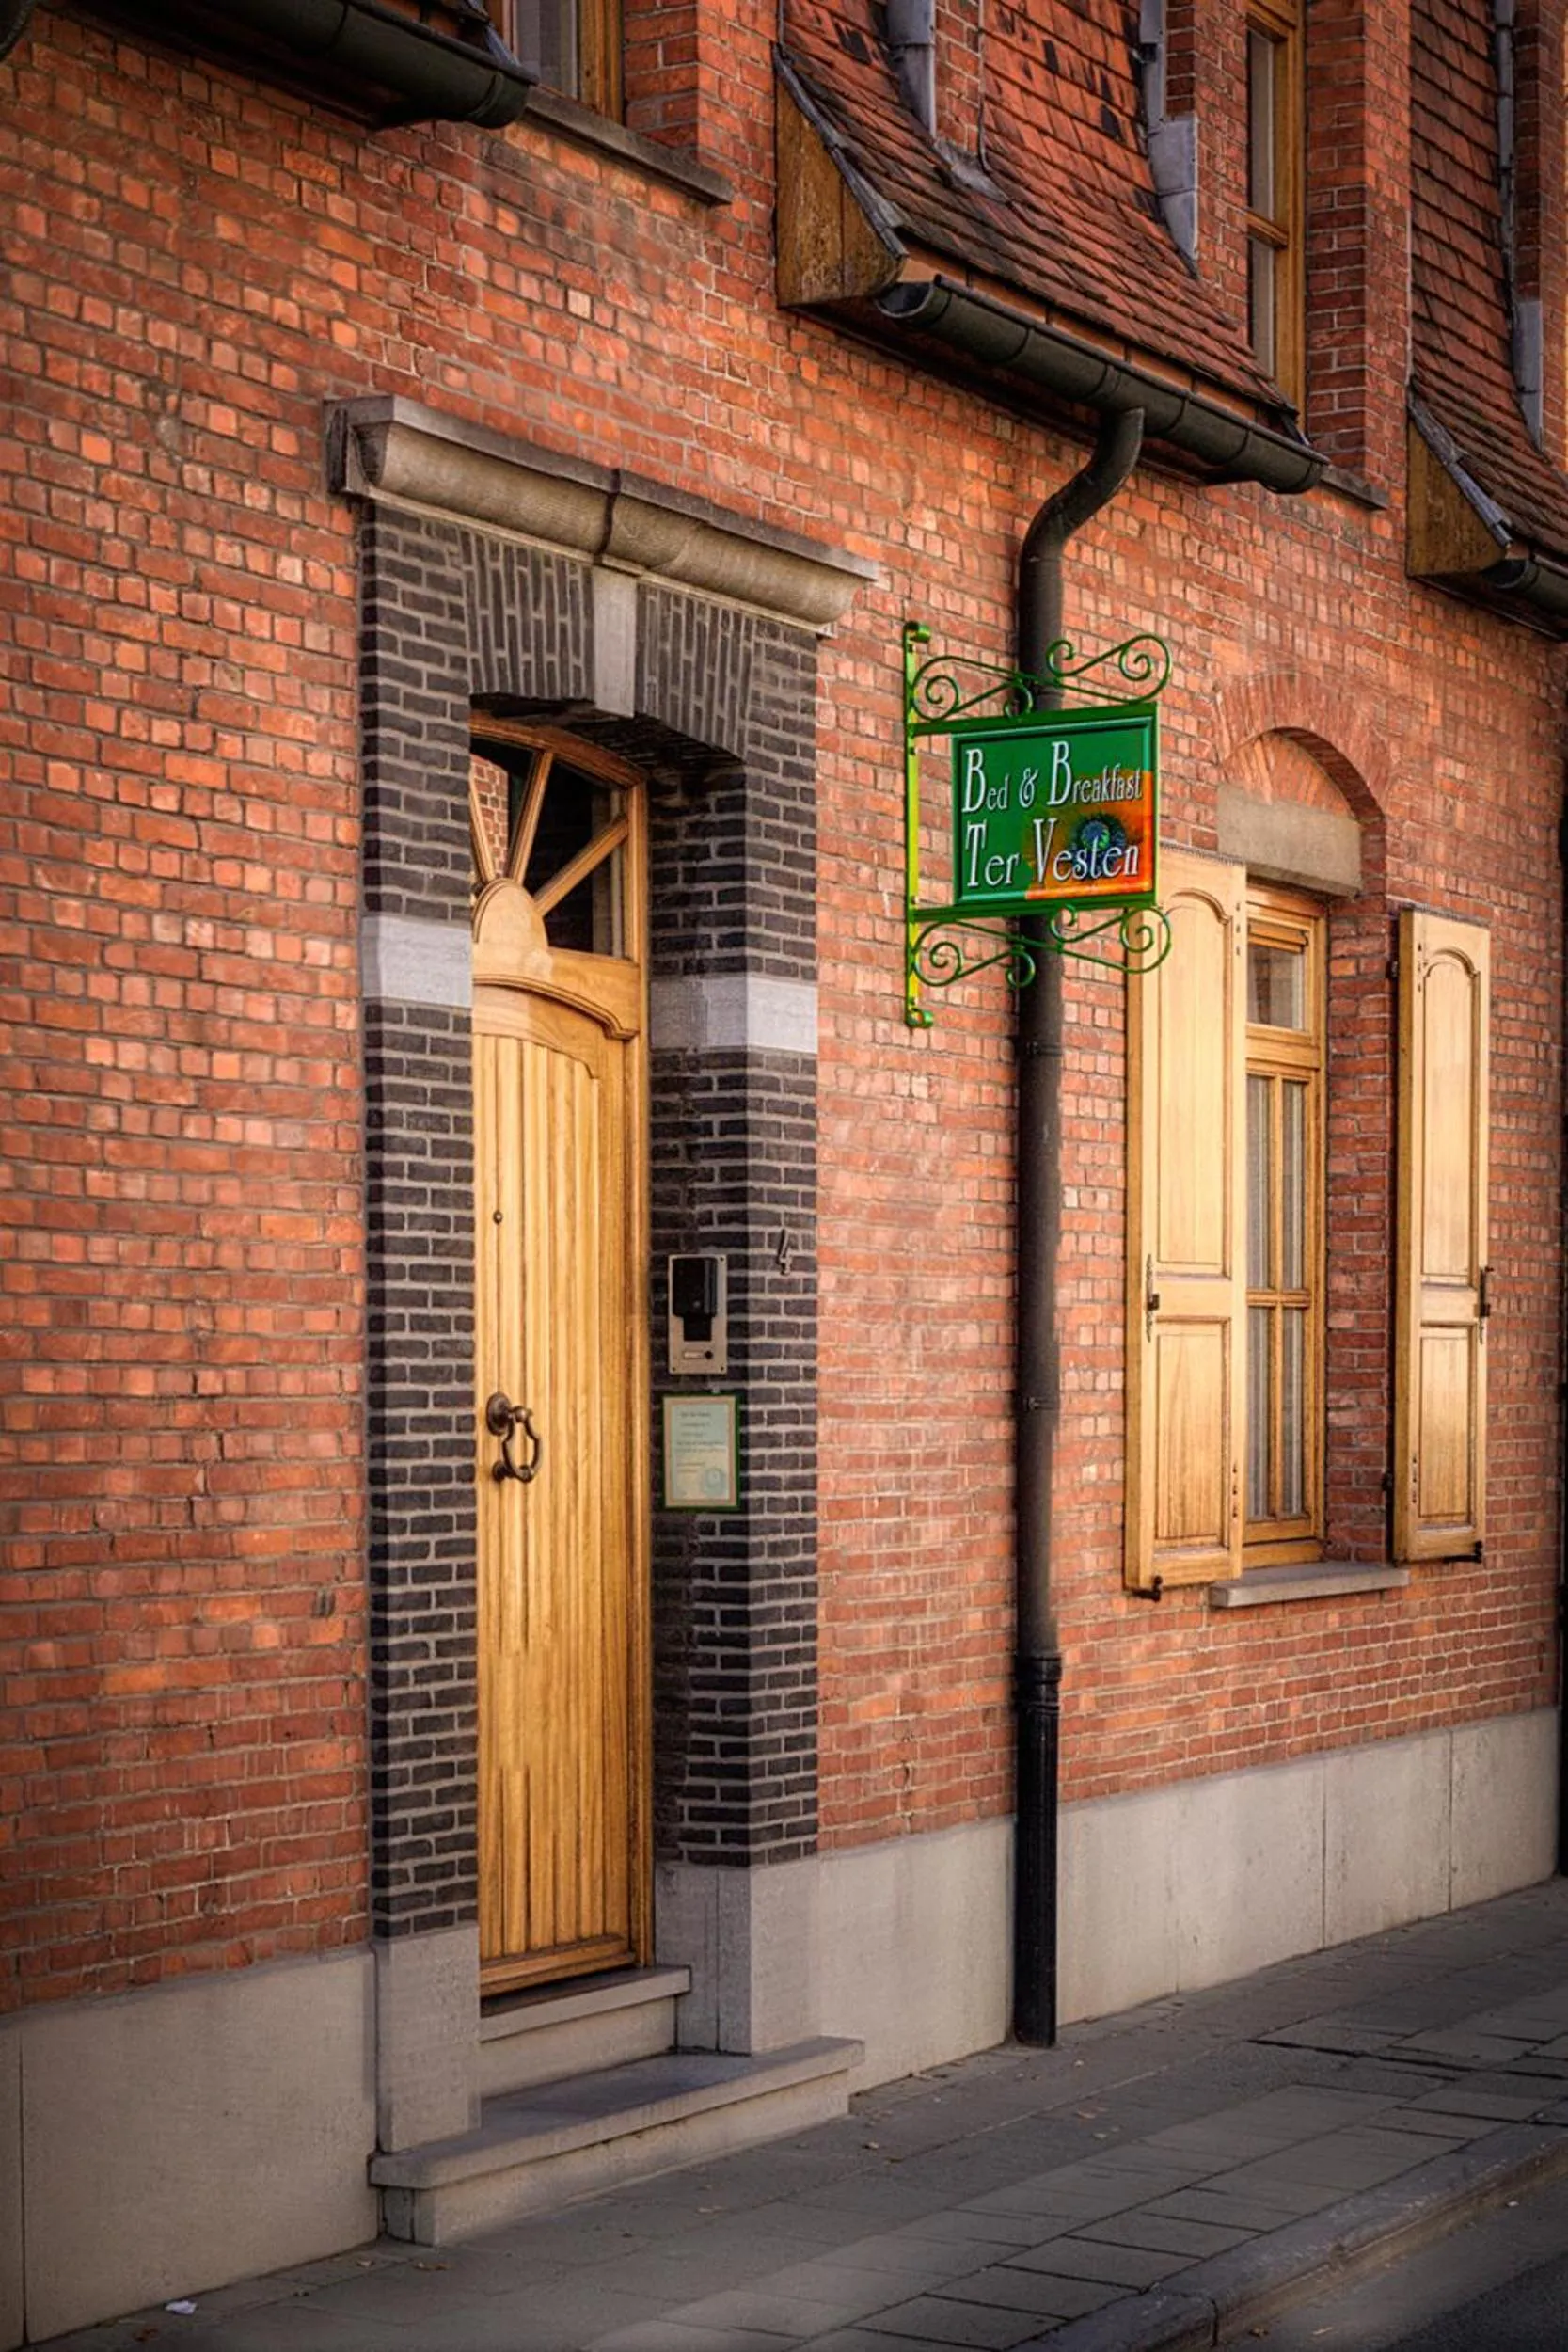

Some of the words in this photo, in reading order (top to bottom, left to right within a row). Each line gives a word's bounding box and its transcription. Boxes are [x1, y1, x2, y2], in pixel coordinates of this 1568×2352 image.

[961, 748, 1010, 813] Bed
[1019, 767, 1039, 809] &
[1047, 740, 1143, 806] Breakfast
[965, 818, 1020, 887] Ter
[1033, 817, 1140, 883] Vesten
